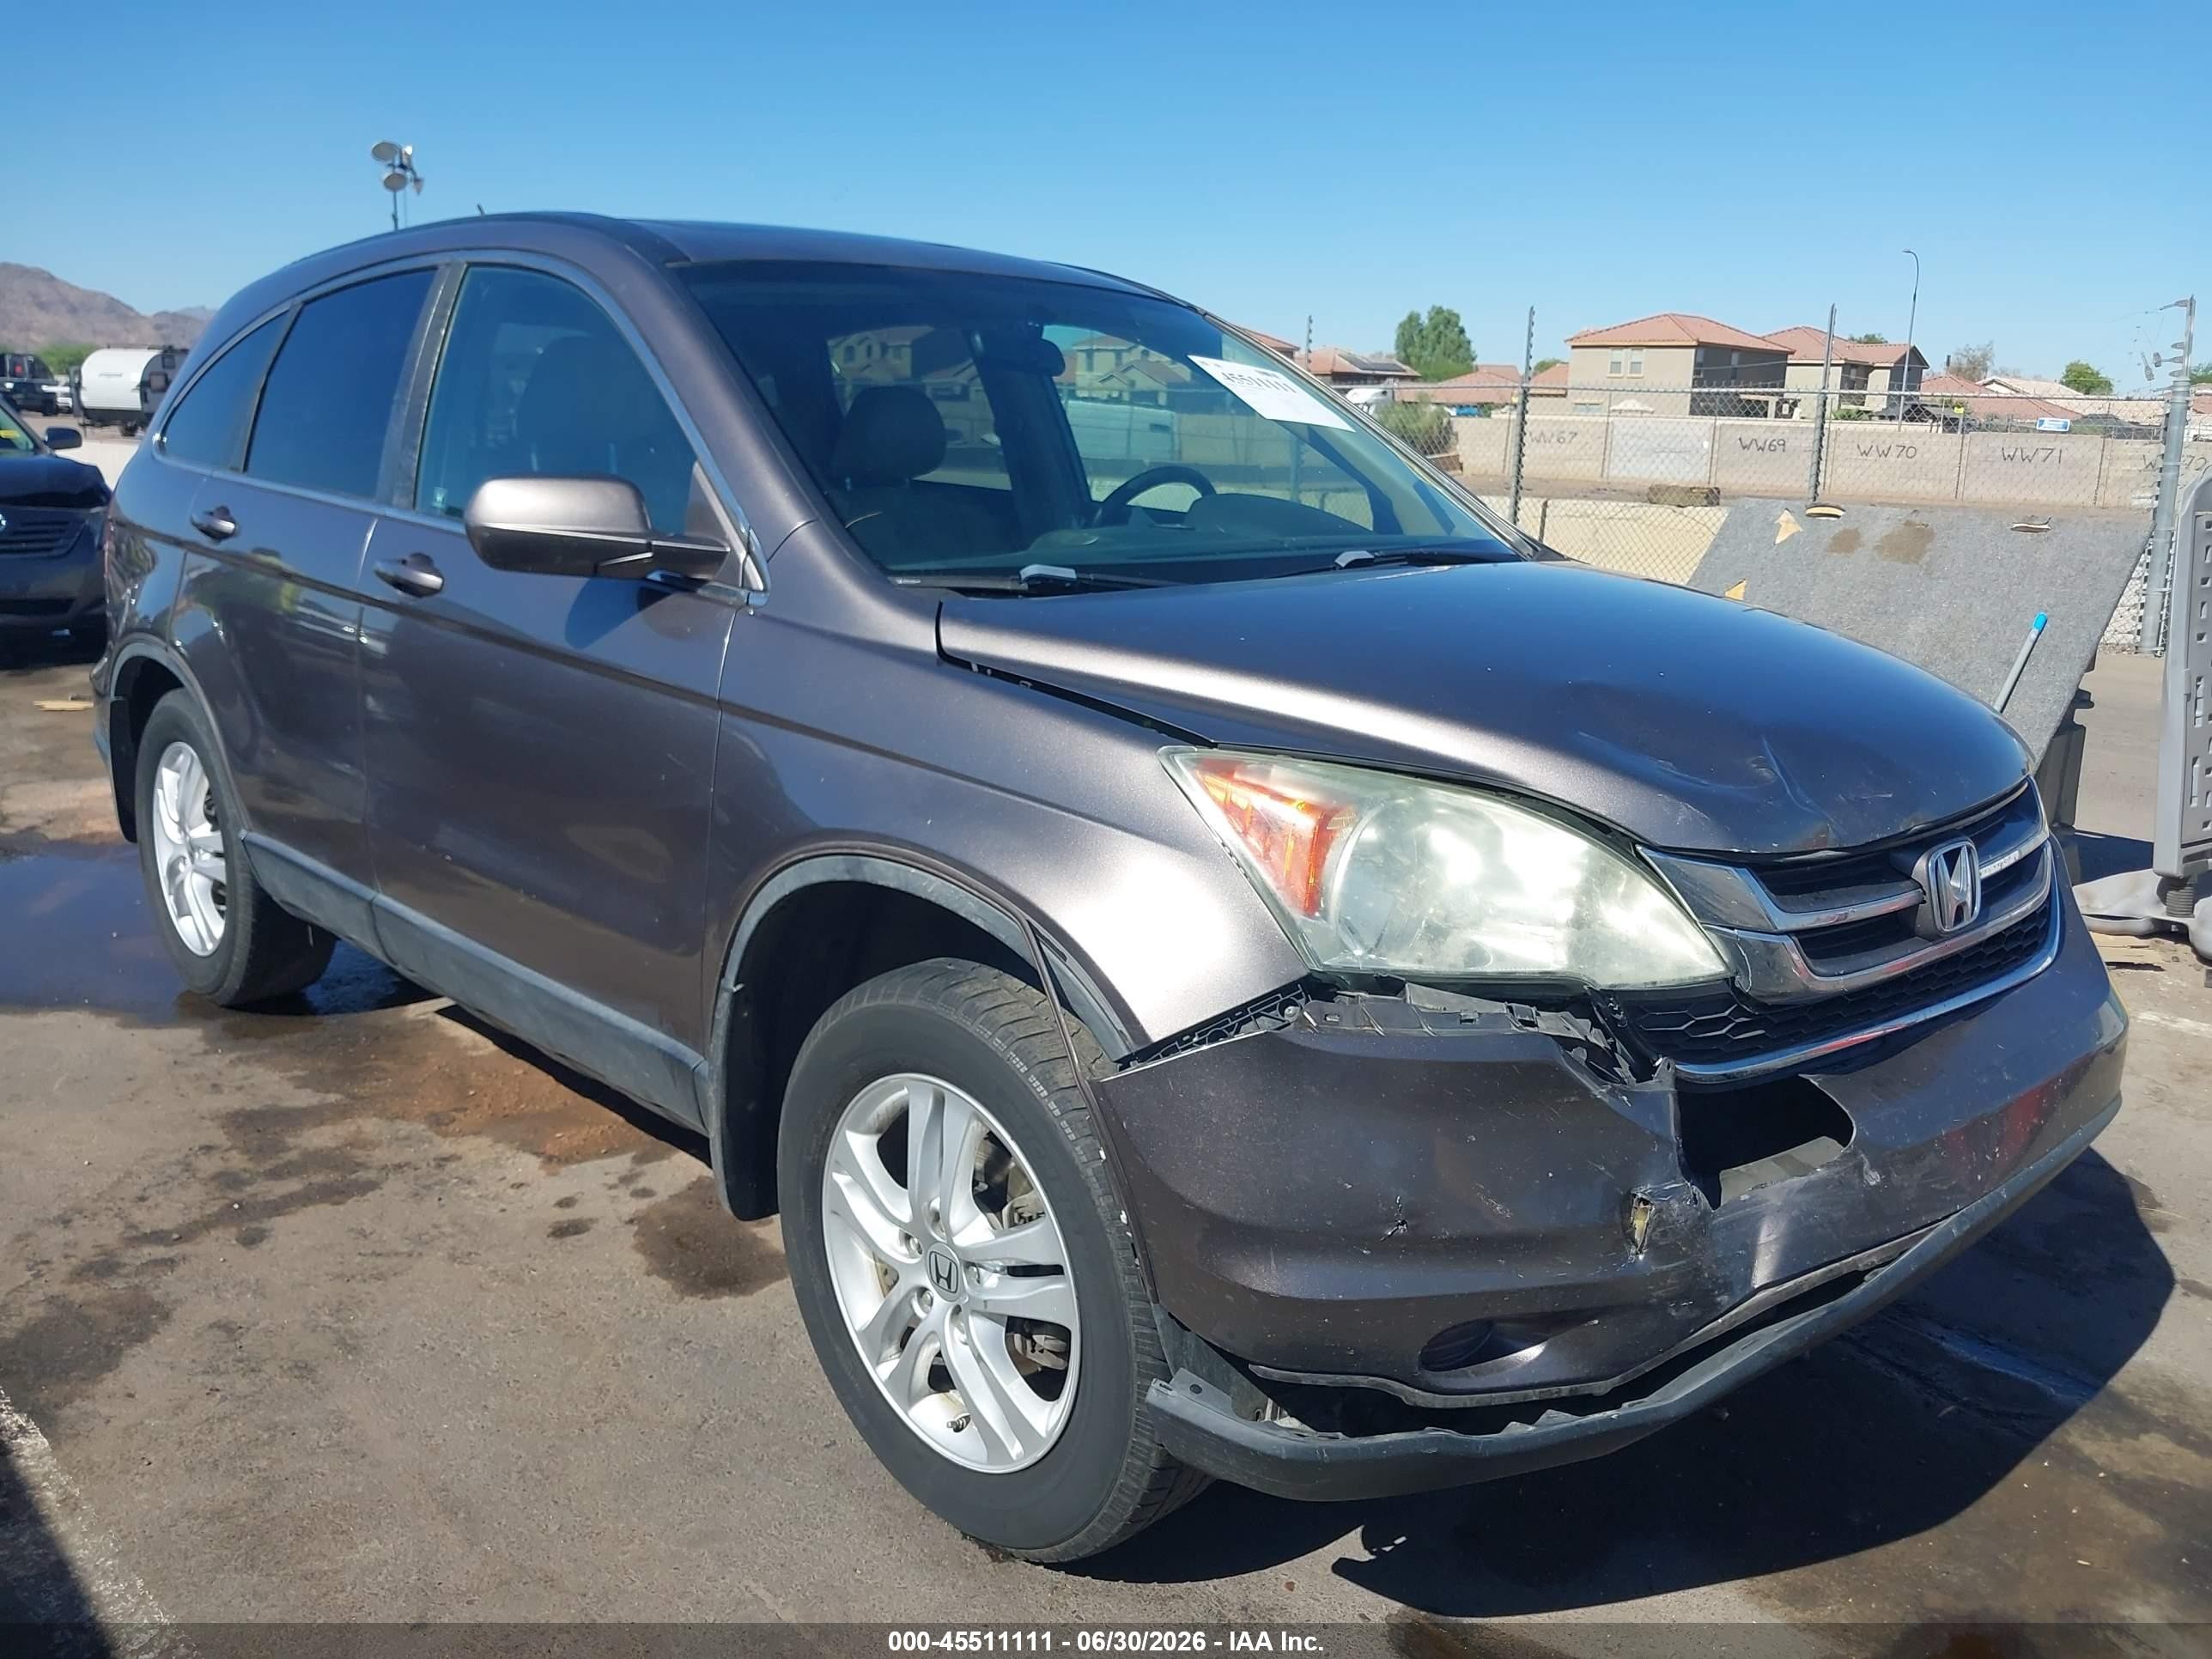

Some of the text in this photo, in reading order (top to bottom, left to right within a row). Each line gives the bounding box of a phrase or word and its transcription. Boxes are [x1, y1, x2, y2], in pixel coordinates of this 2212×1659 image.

[1737, 436, 1787, 453] WW69
[1856, 443, 1918, 459] WW70
[2001, 446, 2063, 465] WW71
